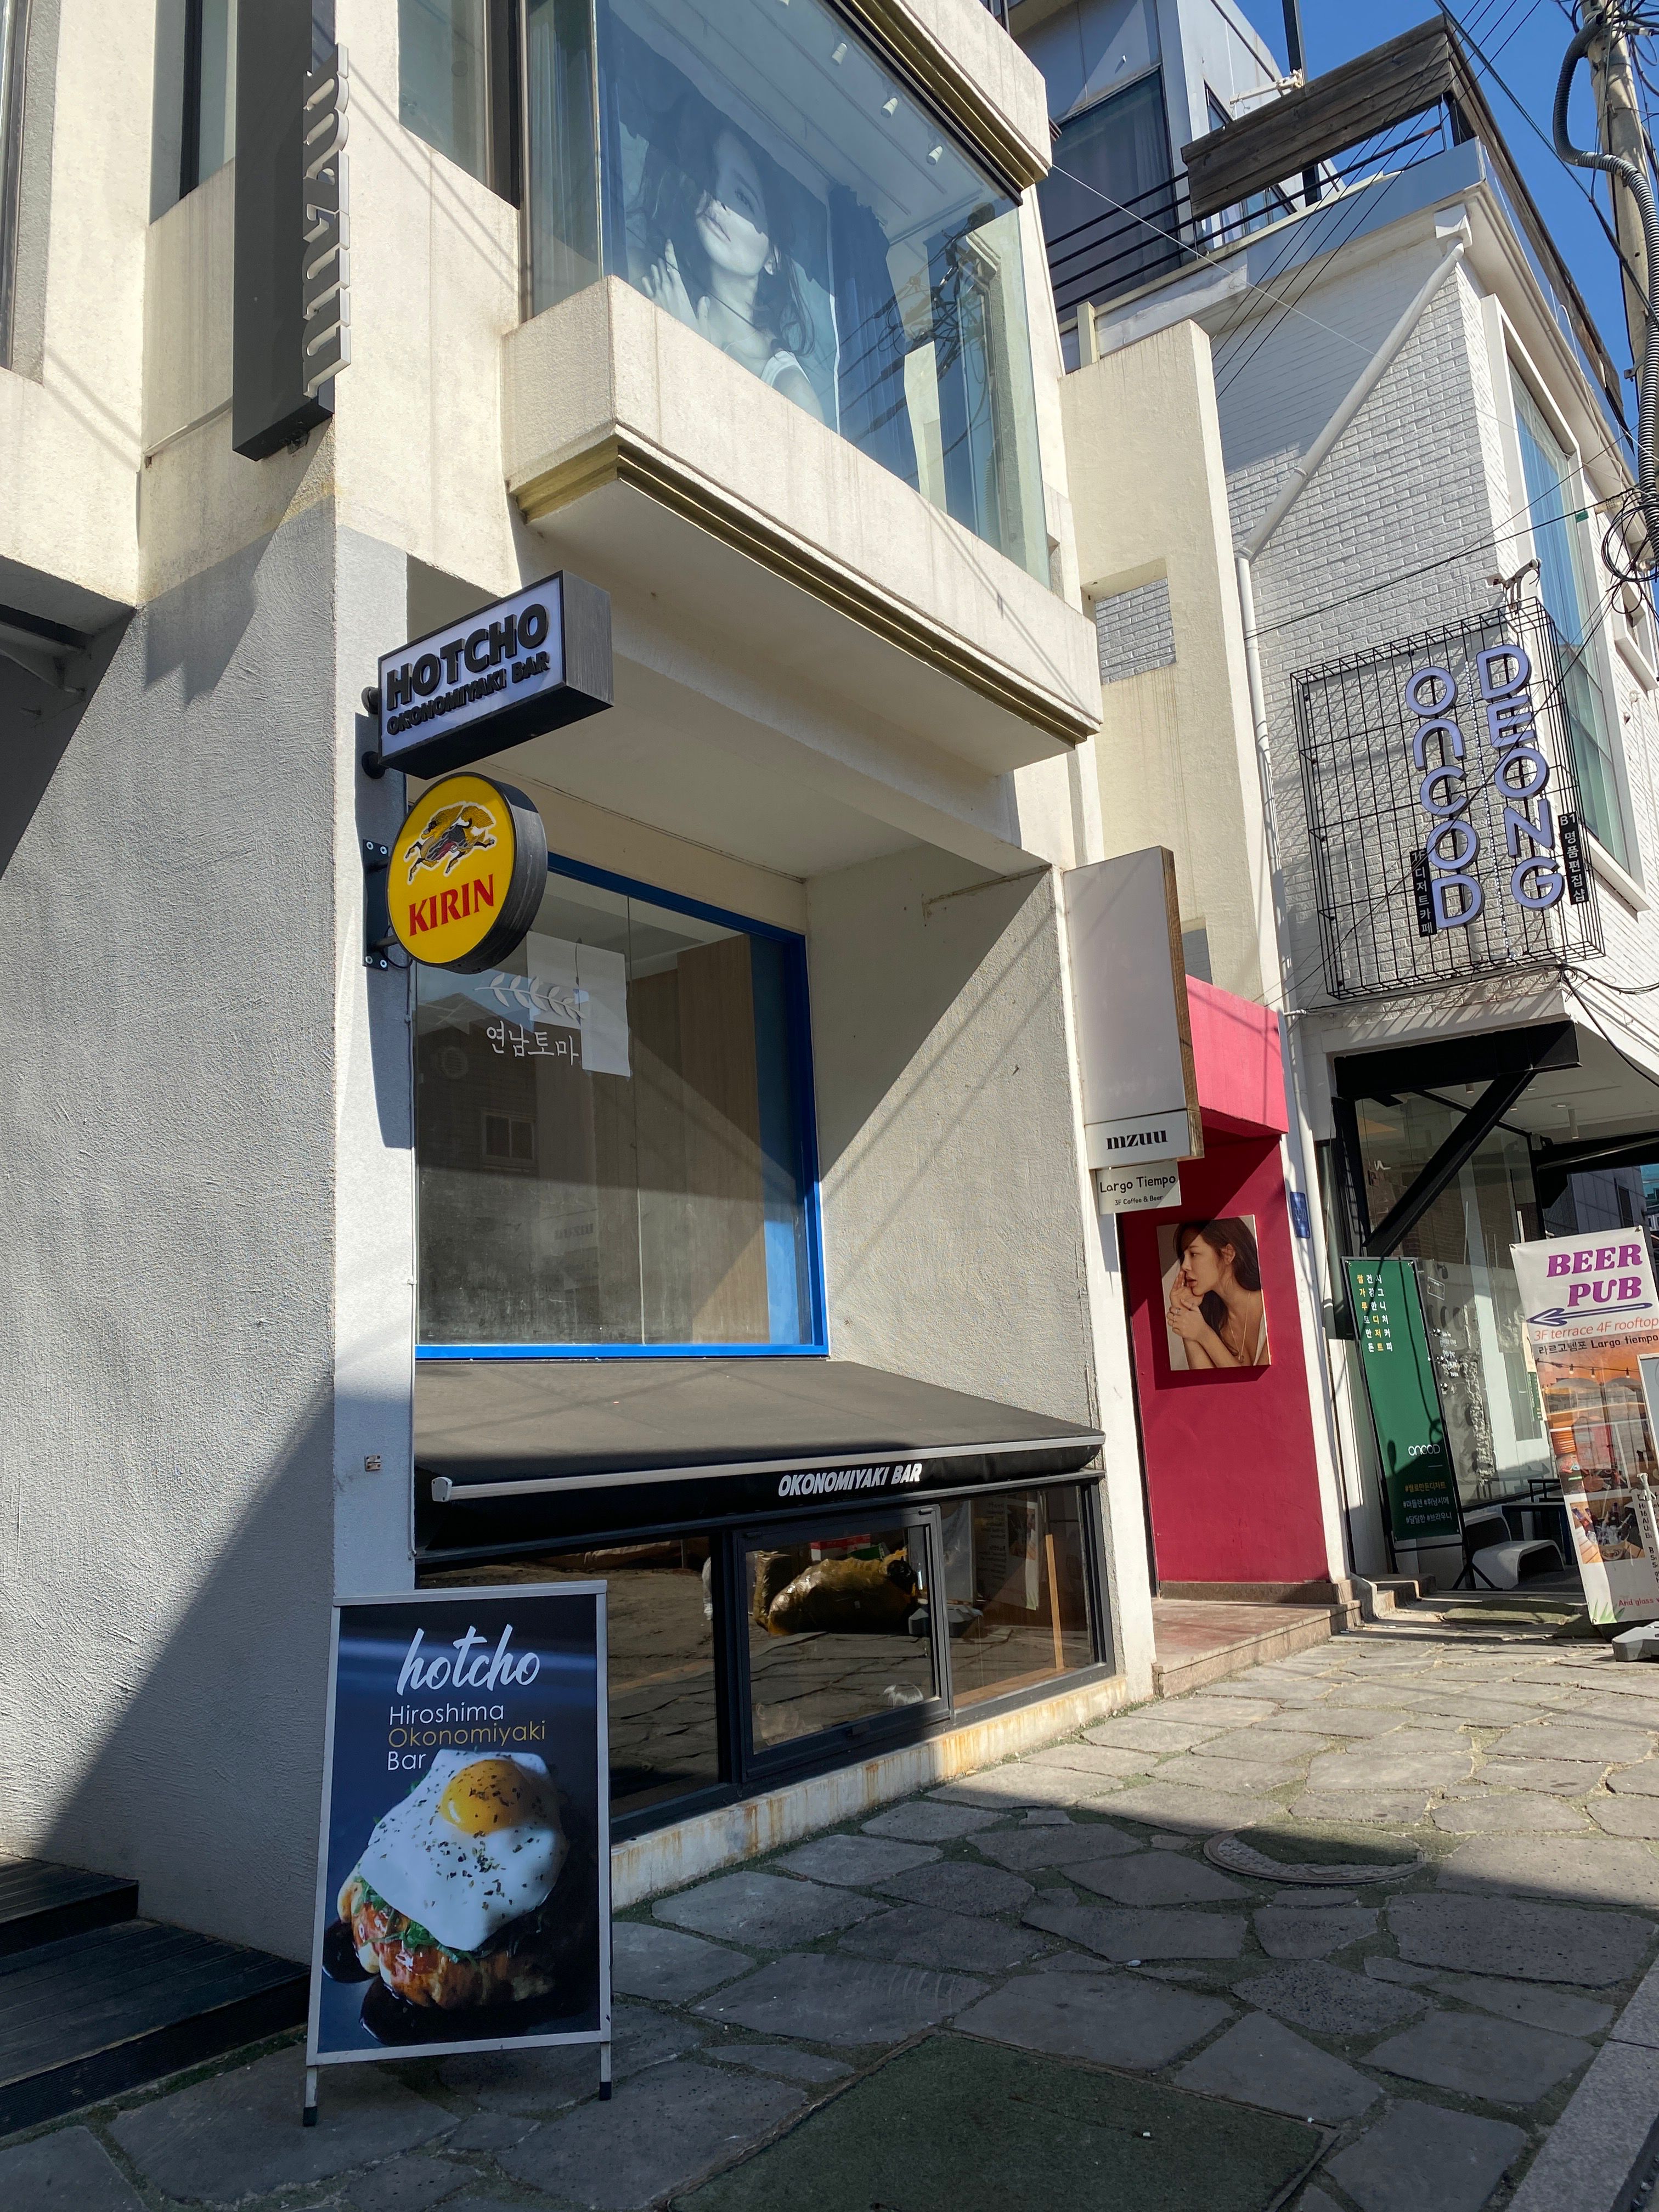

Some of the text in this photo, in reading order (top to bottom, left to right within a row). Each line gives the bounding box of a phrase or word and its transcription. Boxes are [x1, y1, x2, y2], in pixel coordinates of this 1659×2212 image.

[386, 603, 549, 711] HOTCHO
[387, 651, 551, 736] OKONOMIYAKI BAR
[1476, 644, 1565, 911] DEONG
[1560, 814, 1576, 826] B1
[409, 874, 494, 936] KIRIN
[1415, 866, 1433, 934] 디저트카페
[486, 1020, 579, 1065] 연남토마
[1106, 1130, 1169, 1150] mzuu
[1100, 1176, 1176, 1193] Largo Tiempo
[1547, 1244, 1643, 1278] BEER
[1567, 1277, 1642, 1307] PUB
[1534, 1317, 1659, 1341] 3F terrace 4F rooftop
[1592, 1338, 1621, 1349] Largo
[1624, 1335, 1658, 1345] tiempo
[778, 1463, 922, 1497] OKONOMIYAKI BAR
[1427, 1511, 1452, 1522] #브라우니
[1635, 1598, 1654, 1606] glass
[396, 1624, 540, 1696] hotcho
[390, 1702, 504, 1726] Hiroshima
[388, 1720, 546, 1749] Okonomiyaki
[387, 1750, 426, 1771] Bar
